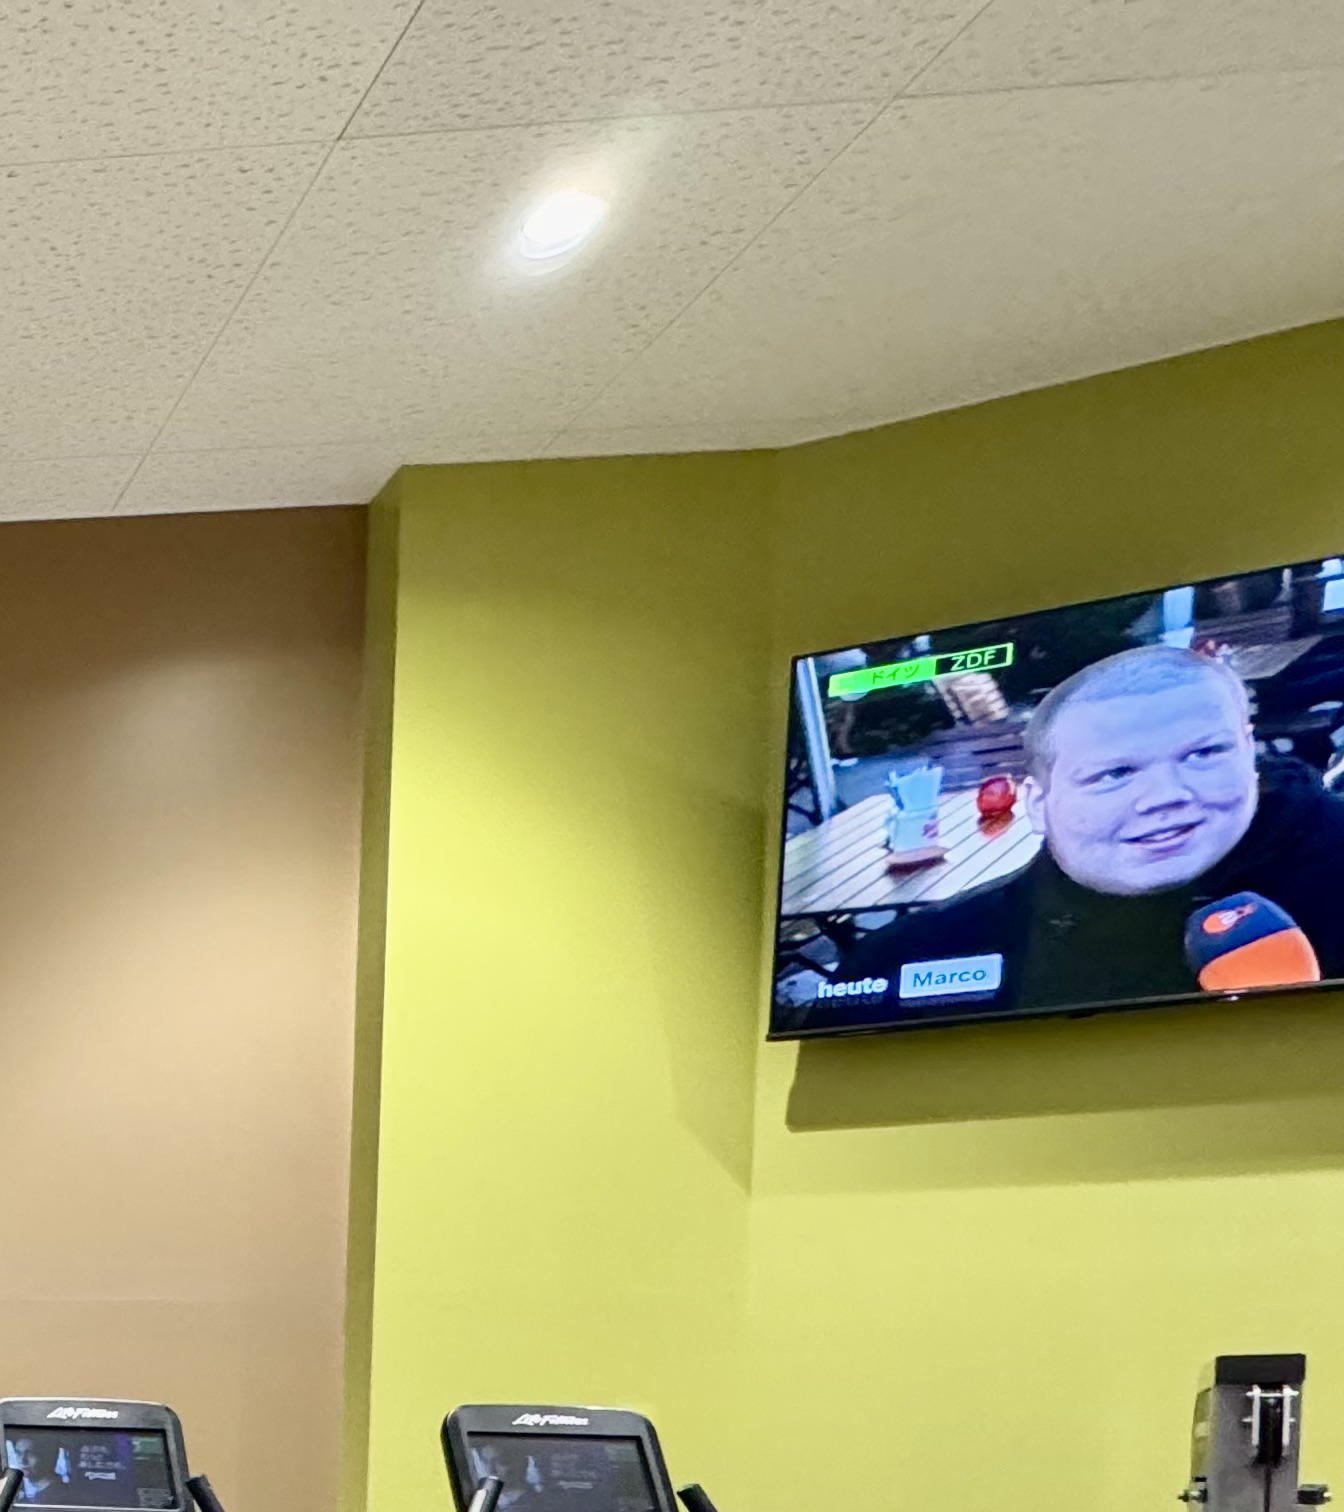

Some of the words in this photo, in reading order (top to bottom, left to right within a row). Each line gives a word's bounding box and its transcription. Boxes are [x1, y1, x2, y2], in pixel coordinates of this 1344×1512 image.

[950, 650, 996, 672] ZDF
[872, 664, 920, 684] ドイツ
[817, 976, 889, 999] heute
[912, 969, 987, 988] Marco
